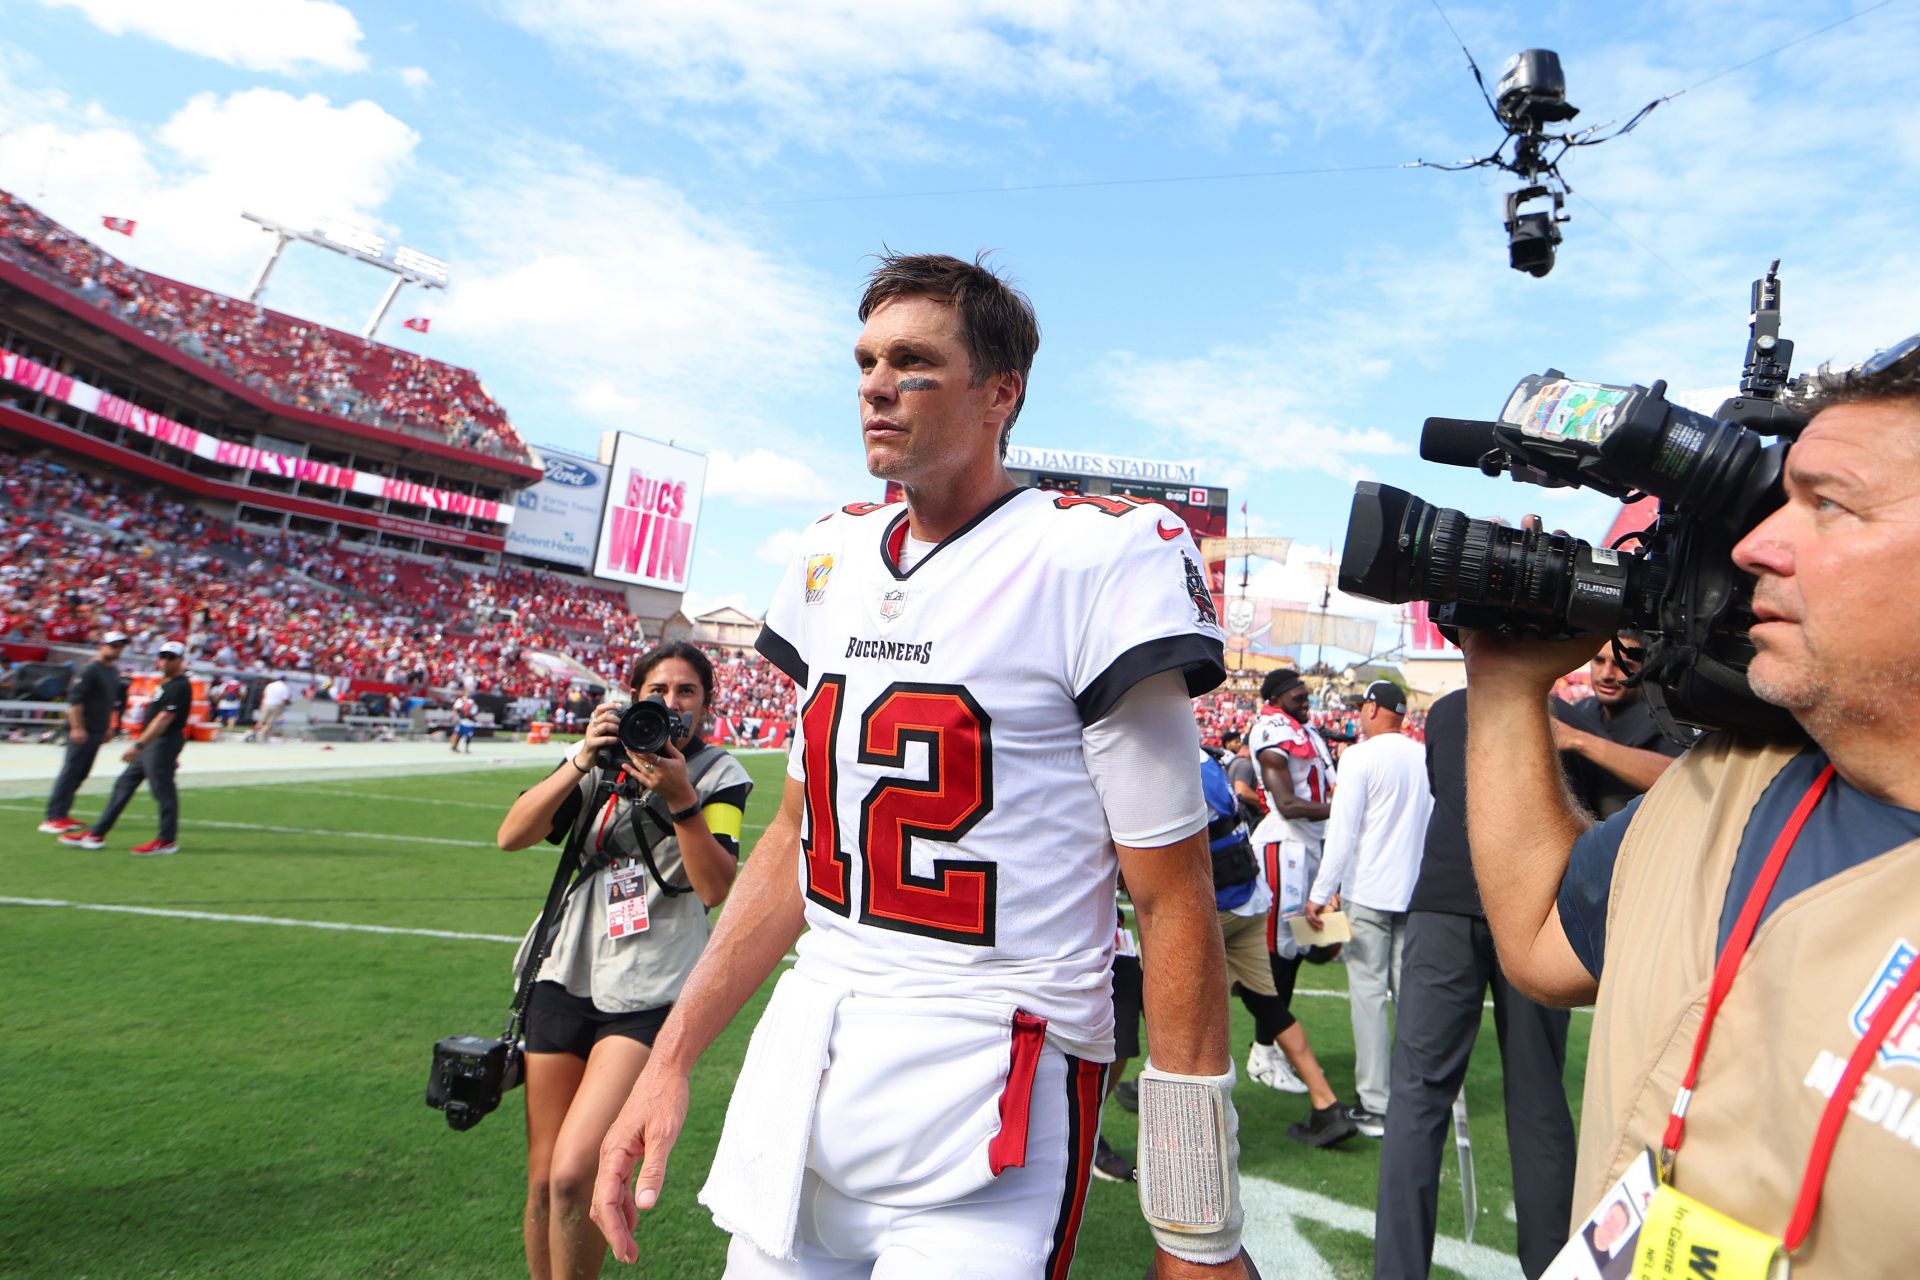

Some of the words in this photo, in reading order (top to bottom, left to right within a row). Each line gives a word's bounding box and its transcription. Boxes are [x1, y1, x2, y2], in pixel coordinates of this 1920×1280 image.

[545, 458, 588, 486] Ford
[1035, 451, 1102, 473] JAMES
[1108, 459, 1197, 483] STADIUM
[625, 467, 688, 518] BUCS
[607, 505, 693, 584] WIN
[1577, 582, 1621, 597] FUJINON
[881, 602, 899, 615] NFL
[802, 673, 997, 948] 12
